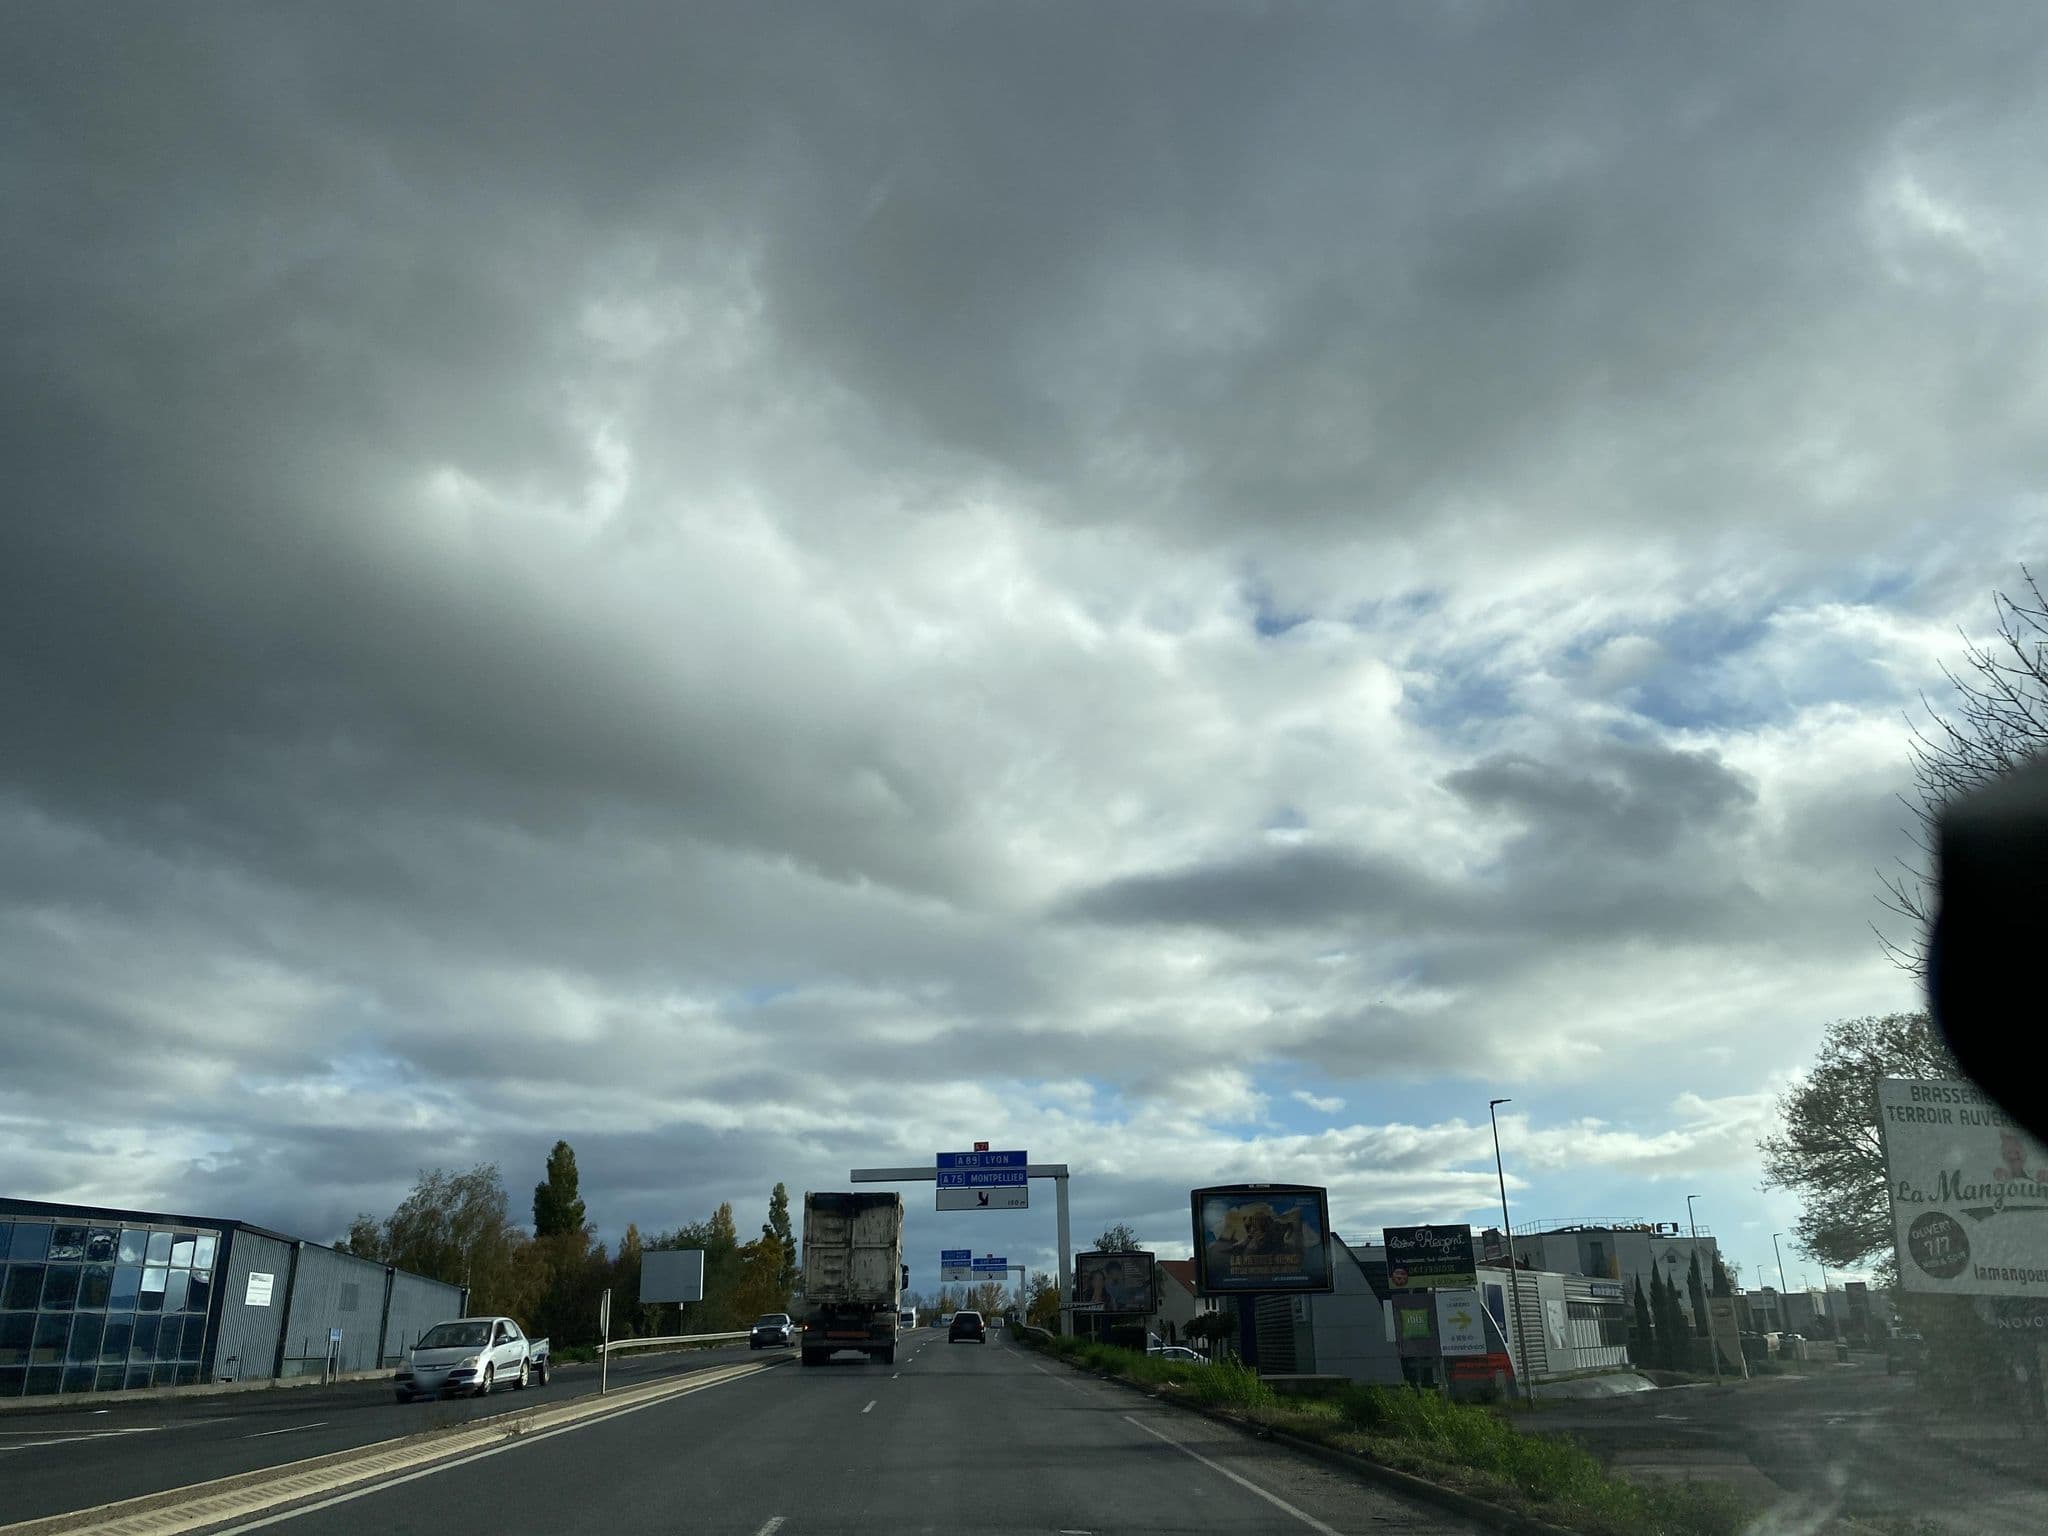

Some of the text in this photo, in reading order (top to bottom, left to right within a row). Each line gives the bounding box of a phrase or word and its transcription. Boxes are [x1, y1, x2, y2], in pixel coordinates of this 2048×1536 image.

[1886, 1105, 2013, 1128] TERROIR AUVER
[985, 1155, 1009, 1164] LYON
[970, 1173, 1024, 1184] MONTPELLIER
[1897, 1181, 1924, 1203] La
